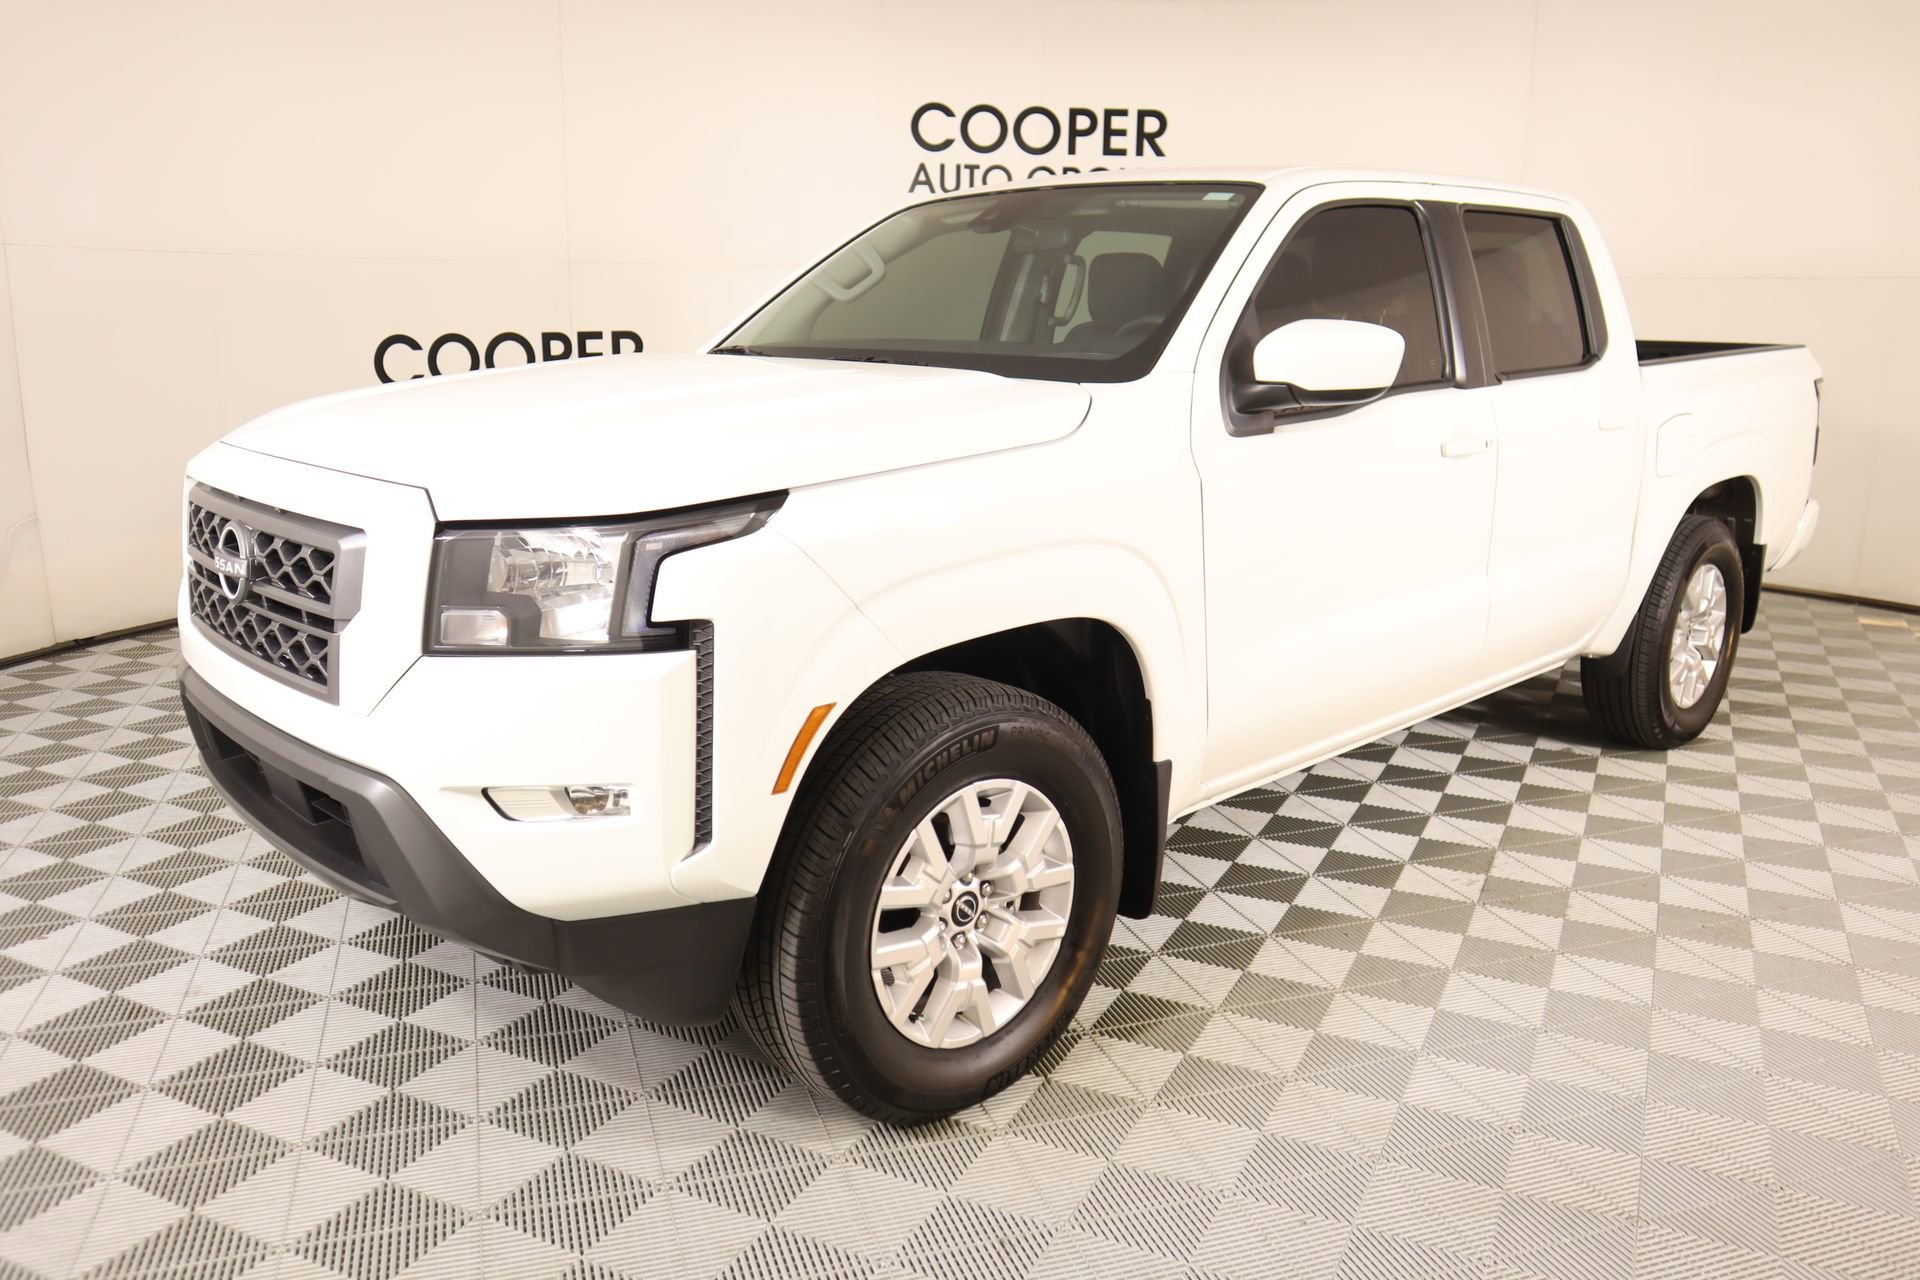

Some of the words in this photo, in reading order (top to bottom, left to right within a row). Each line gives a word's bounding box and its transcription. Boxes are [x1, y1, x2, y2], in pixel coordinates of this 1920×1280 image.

[911, 102, 1168, 157] COOPER
[908, 162, 1013, 194] AUTO
[214, 556, 246, 576] SSAN
[899, 729, 995, 803] MICHELIN
